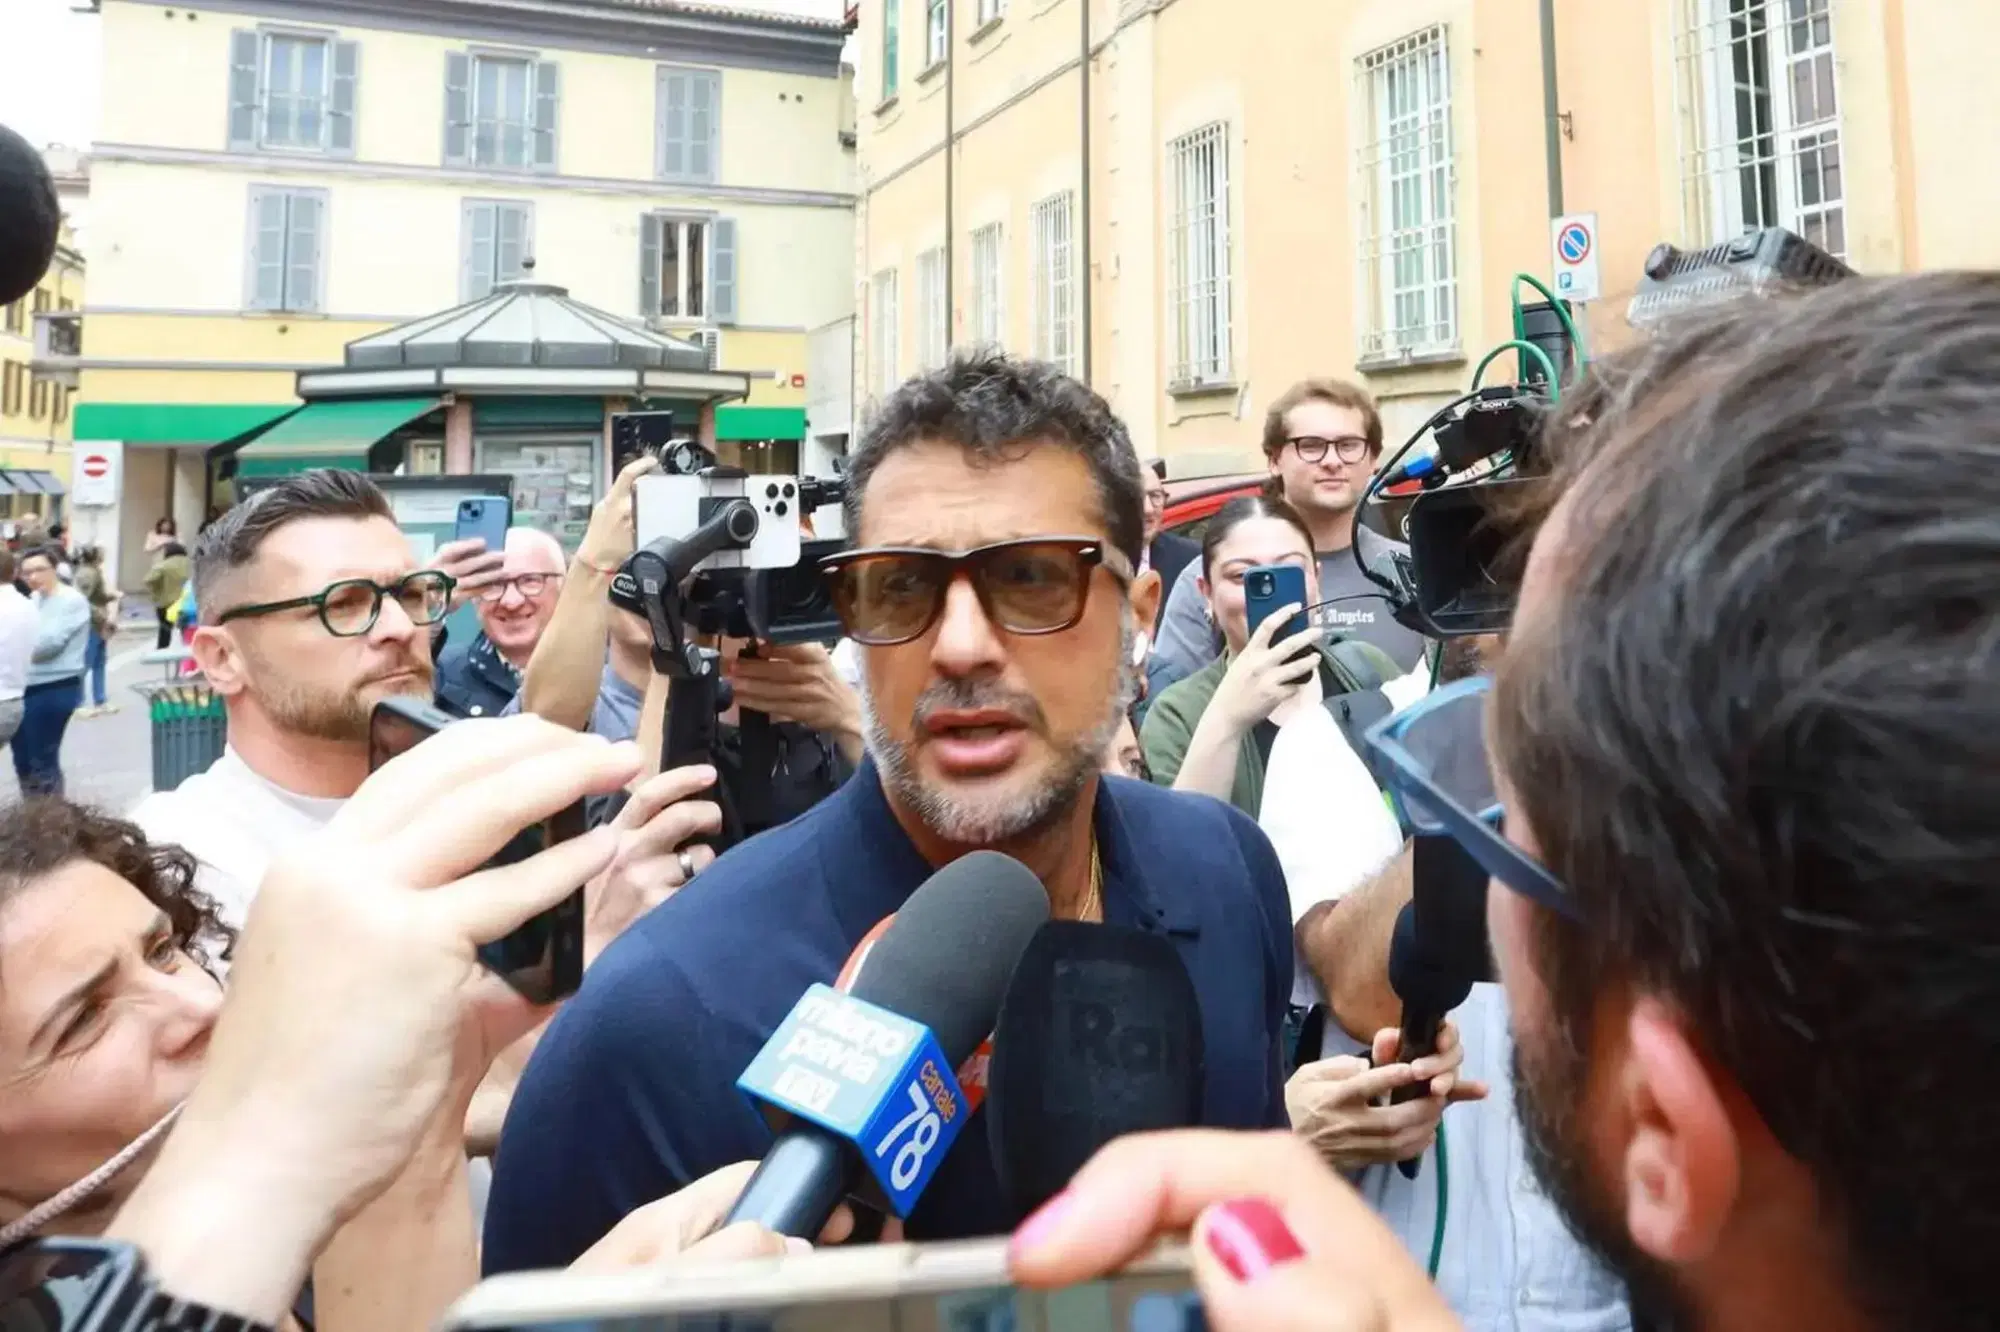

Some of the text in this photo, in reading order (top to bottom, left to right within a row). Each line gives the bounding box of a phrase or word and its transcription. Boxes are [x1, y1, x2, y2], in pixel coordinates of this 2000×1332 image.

[1481, 400, 1508, 409] SONY
[1327, 608, 1375, 625] Angeles
[875, 1079, 941, 1190] 78
